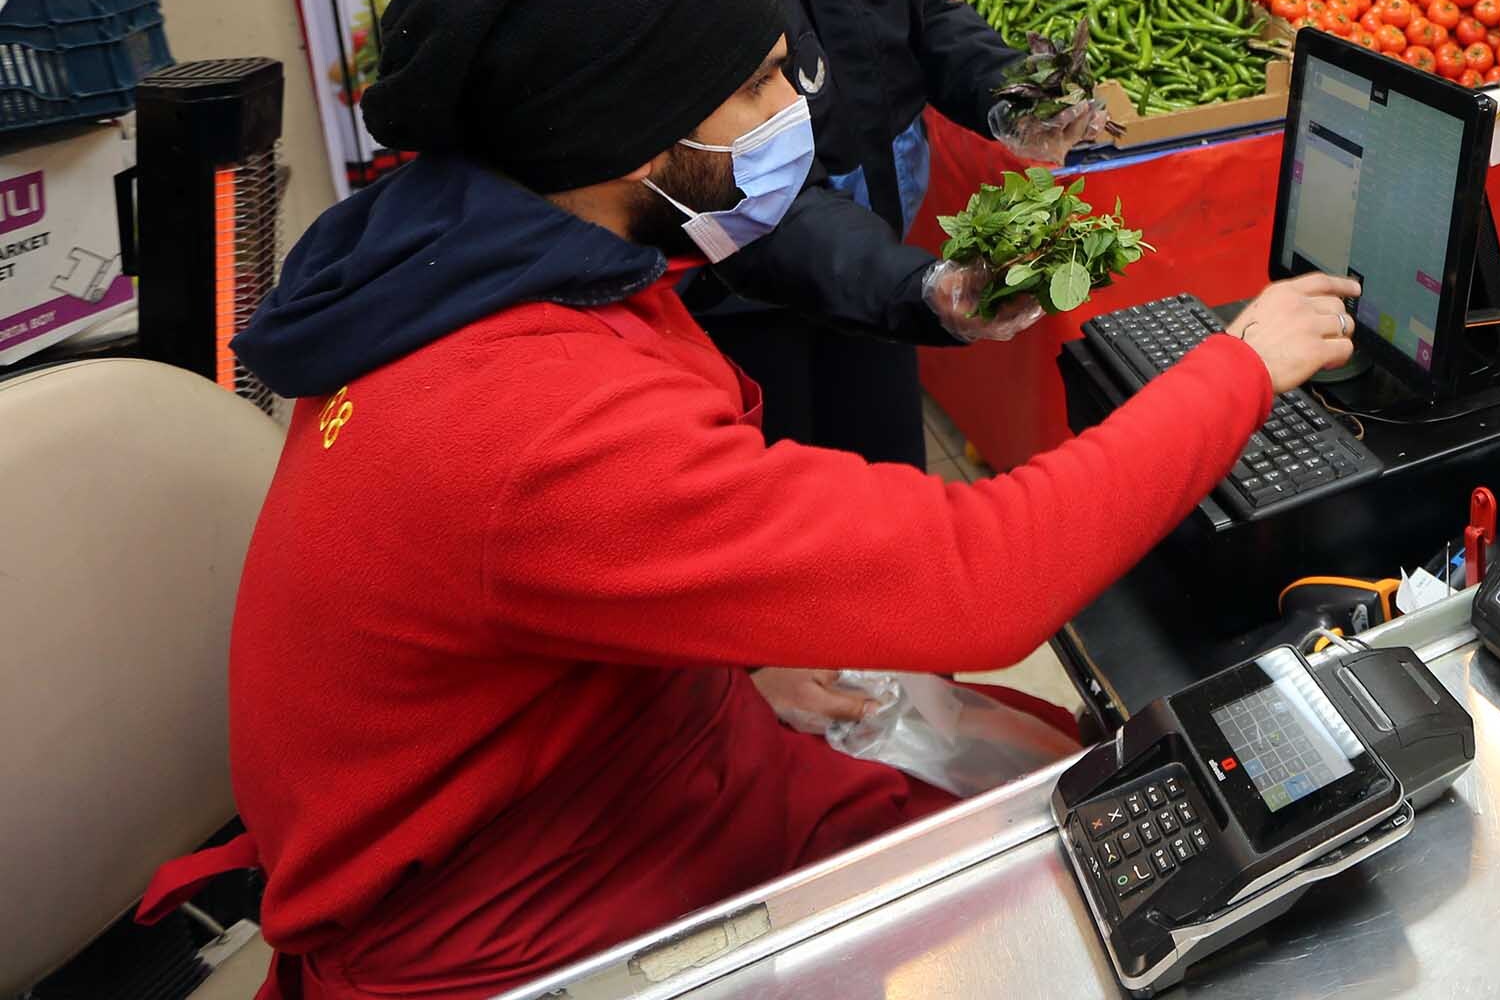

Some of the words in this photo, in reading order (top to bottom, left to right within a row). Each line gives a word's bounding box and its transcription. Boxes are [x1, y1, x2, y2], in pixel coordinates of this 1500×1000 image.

[1179, 802, 1187, 810] 2
[1194, 828, 1202, 836] 3
[1175, 839, 1183, 847] 6
[1155, 849, 1163, 857] 9
